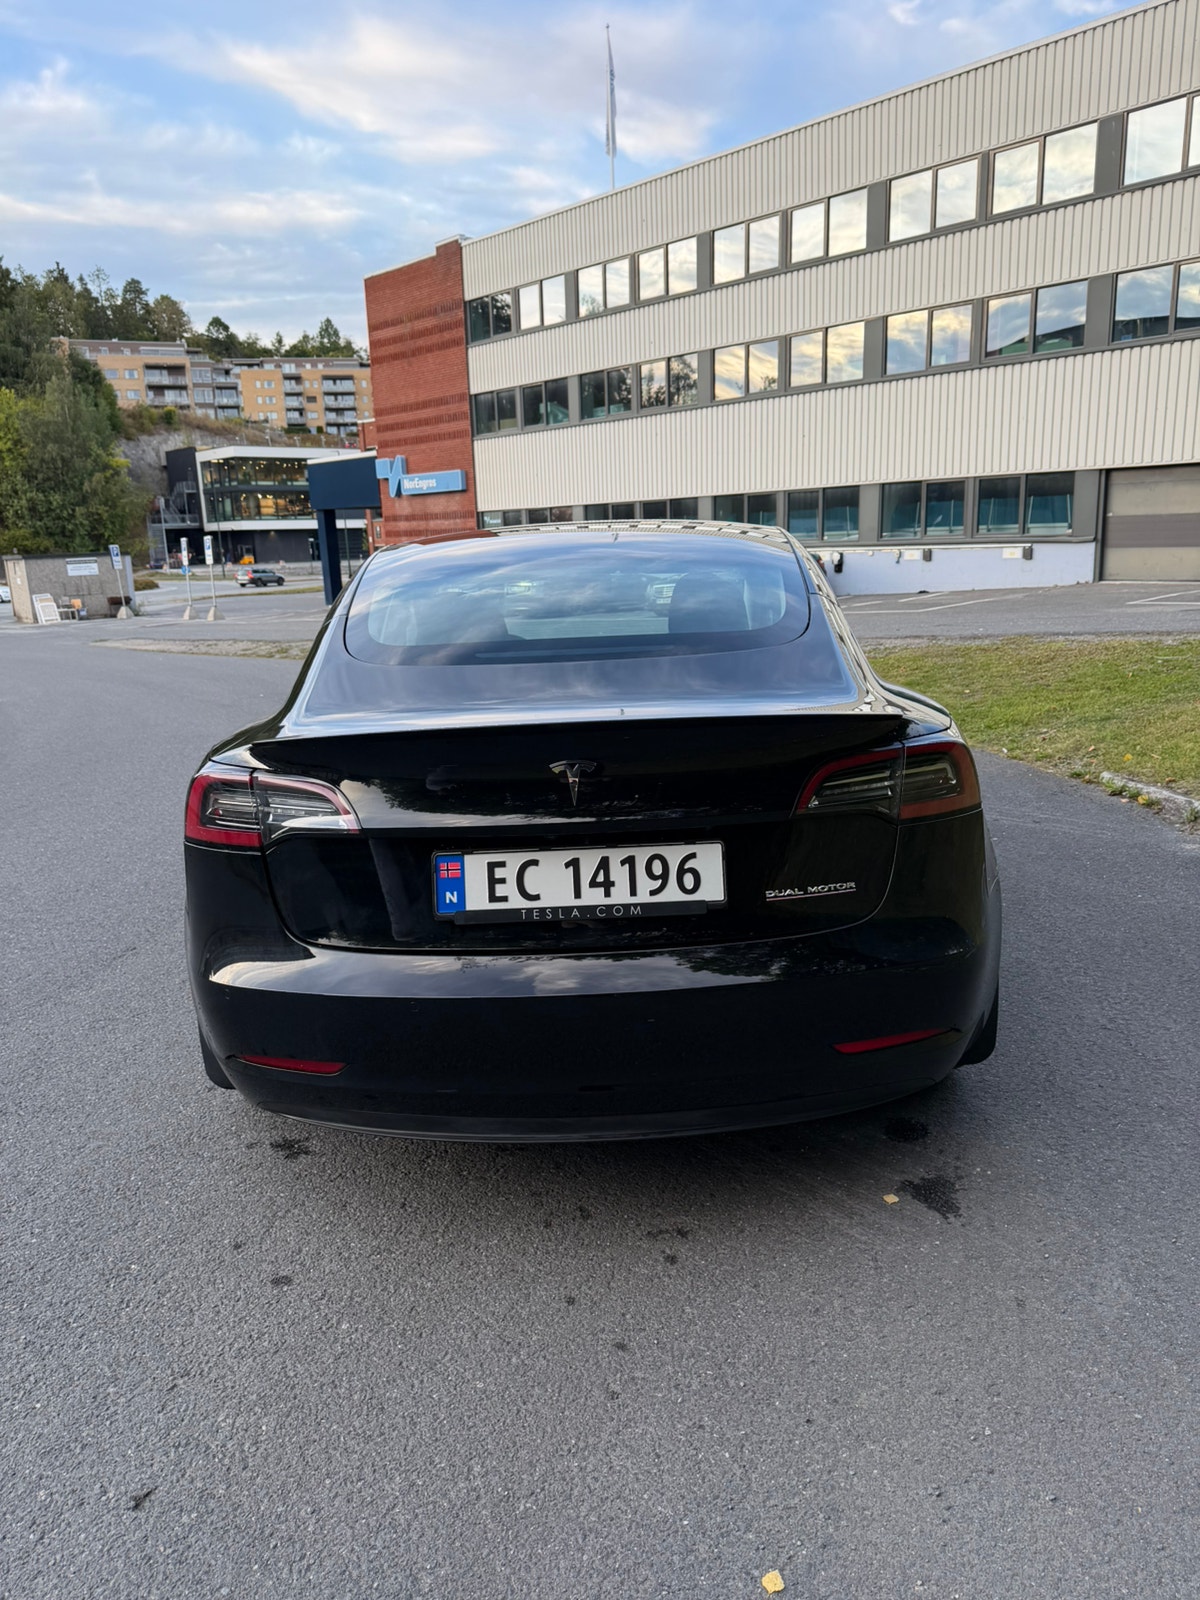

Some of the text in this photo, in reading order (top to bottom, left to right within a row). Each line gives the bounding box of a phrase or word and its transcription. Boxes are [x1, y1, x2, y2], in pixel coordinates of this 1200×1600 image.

[486, 851, 702, 904] EC 14196
[445, 891, 458, 904] N
[765, 881, 856, 898] DUAL MOTOR
[520, 905, 642, 920] TESLA.COM
